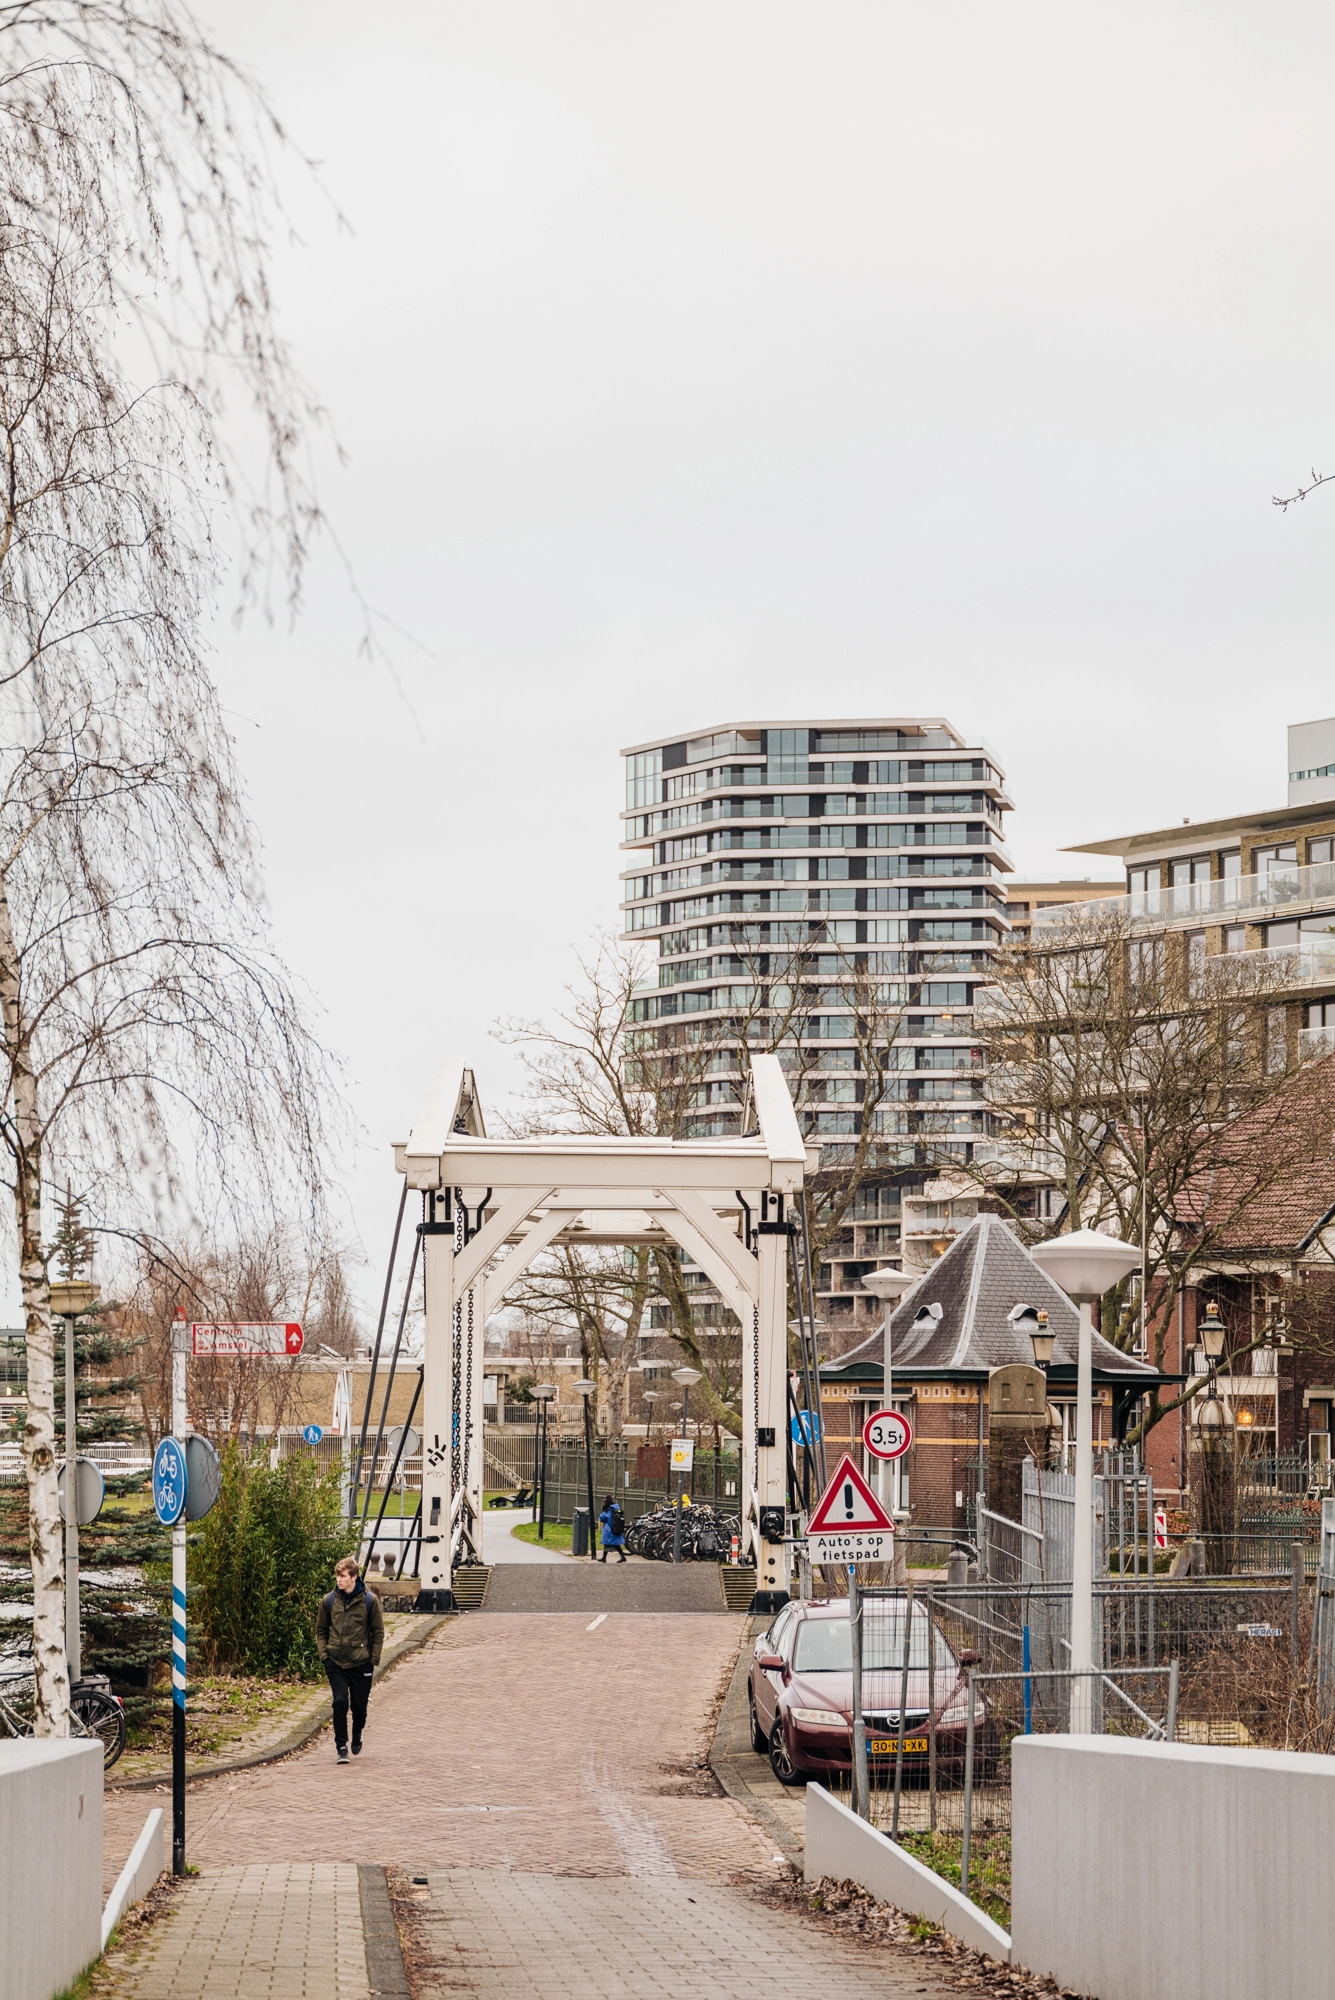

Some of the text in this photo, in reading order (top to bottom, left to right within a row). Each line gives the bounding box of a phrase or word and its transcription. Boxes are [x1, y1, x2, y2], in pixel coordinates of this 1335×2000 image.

[197, 1327, 242, 1336] Centrum
[211, 1341, 247, 1349] Amstel
[818, 1536, 883, 1547] Auto's op
[822, 1548, 879, 1561] fietspad
